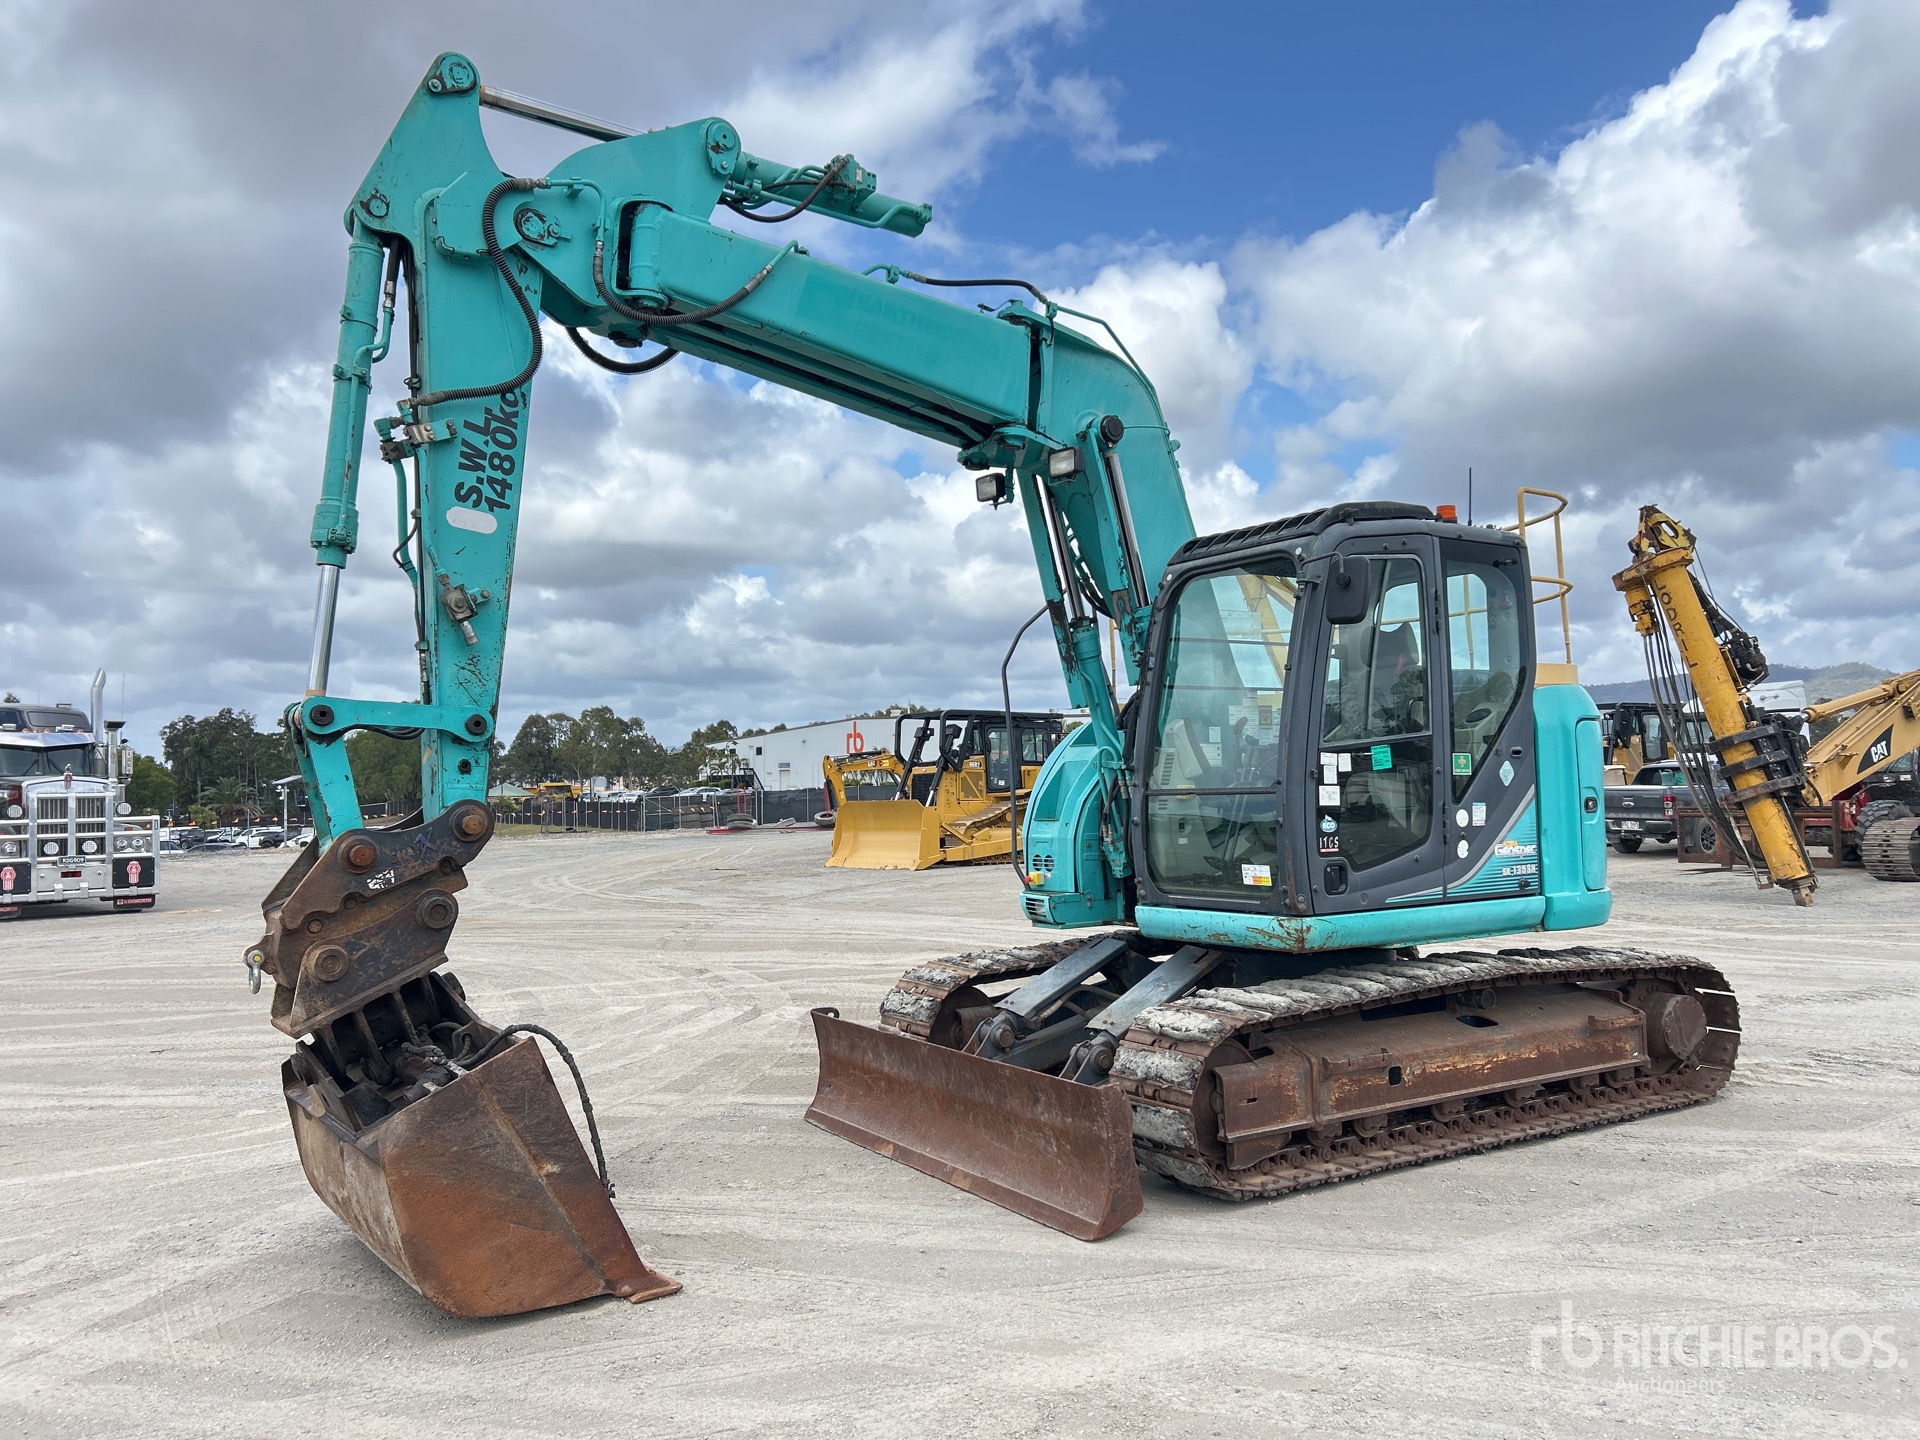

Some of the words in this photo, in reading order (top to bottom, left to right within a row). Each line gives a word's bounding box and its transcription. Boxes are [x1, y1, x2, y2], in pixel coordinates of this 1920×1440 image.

[1654, 579, 1698, 668] LODRIL
[846, 721, 865, 754] rb
[1870, 741, 1889, 763] CAT
[1322, 821, 1336, 830] ECO
[1319, 836, 1339, 849] ITCS
